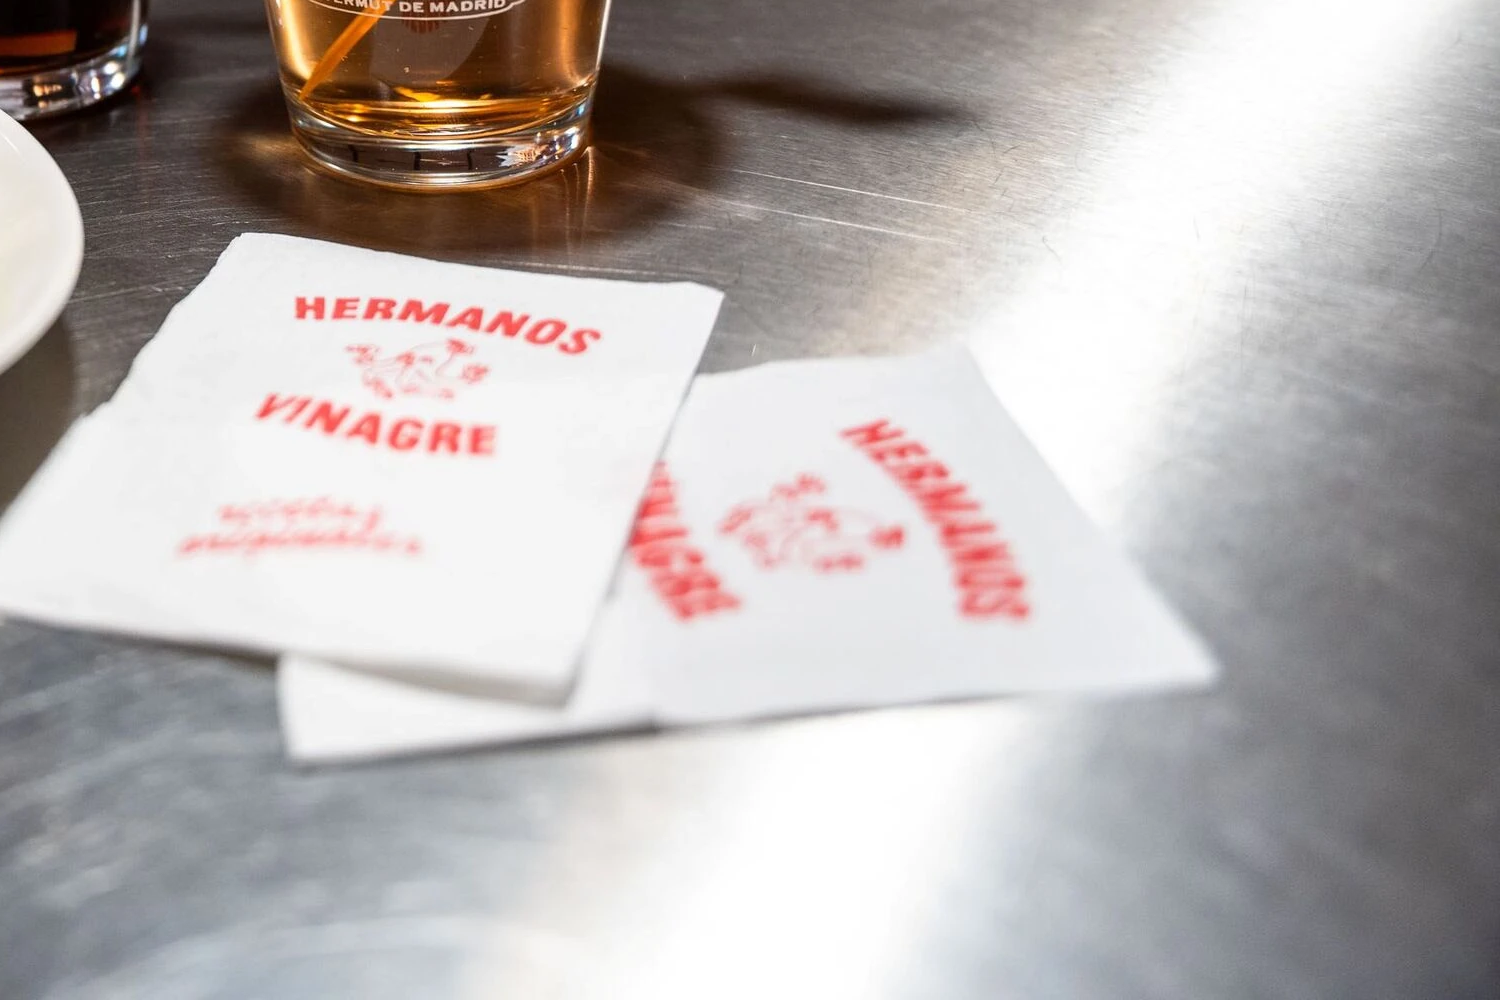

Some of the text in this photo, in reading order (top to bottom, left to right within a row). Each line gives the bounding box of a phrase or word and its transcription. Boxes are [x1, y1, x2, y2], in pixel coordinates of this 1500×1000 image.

[399, 0, 425, 13] DE
[294, 295, 603, 356] HERMANOS
[254, 392, 499, 457] VINAGRE
